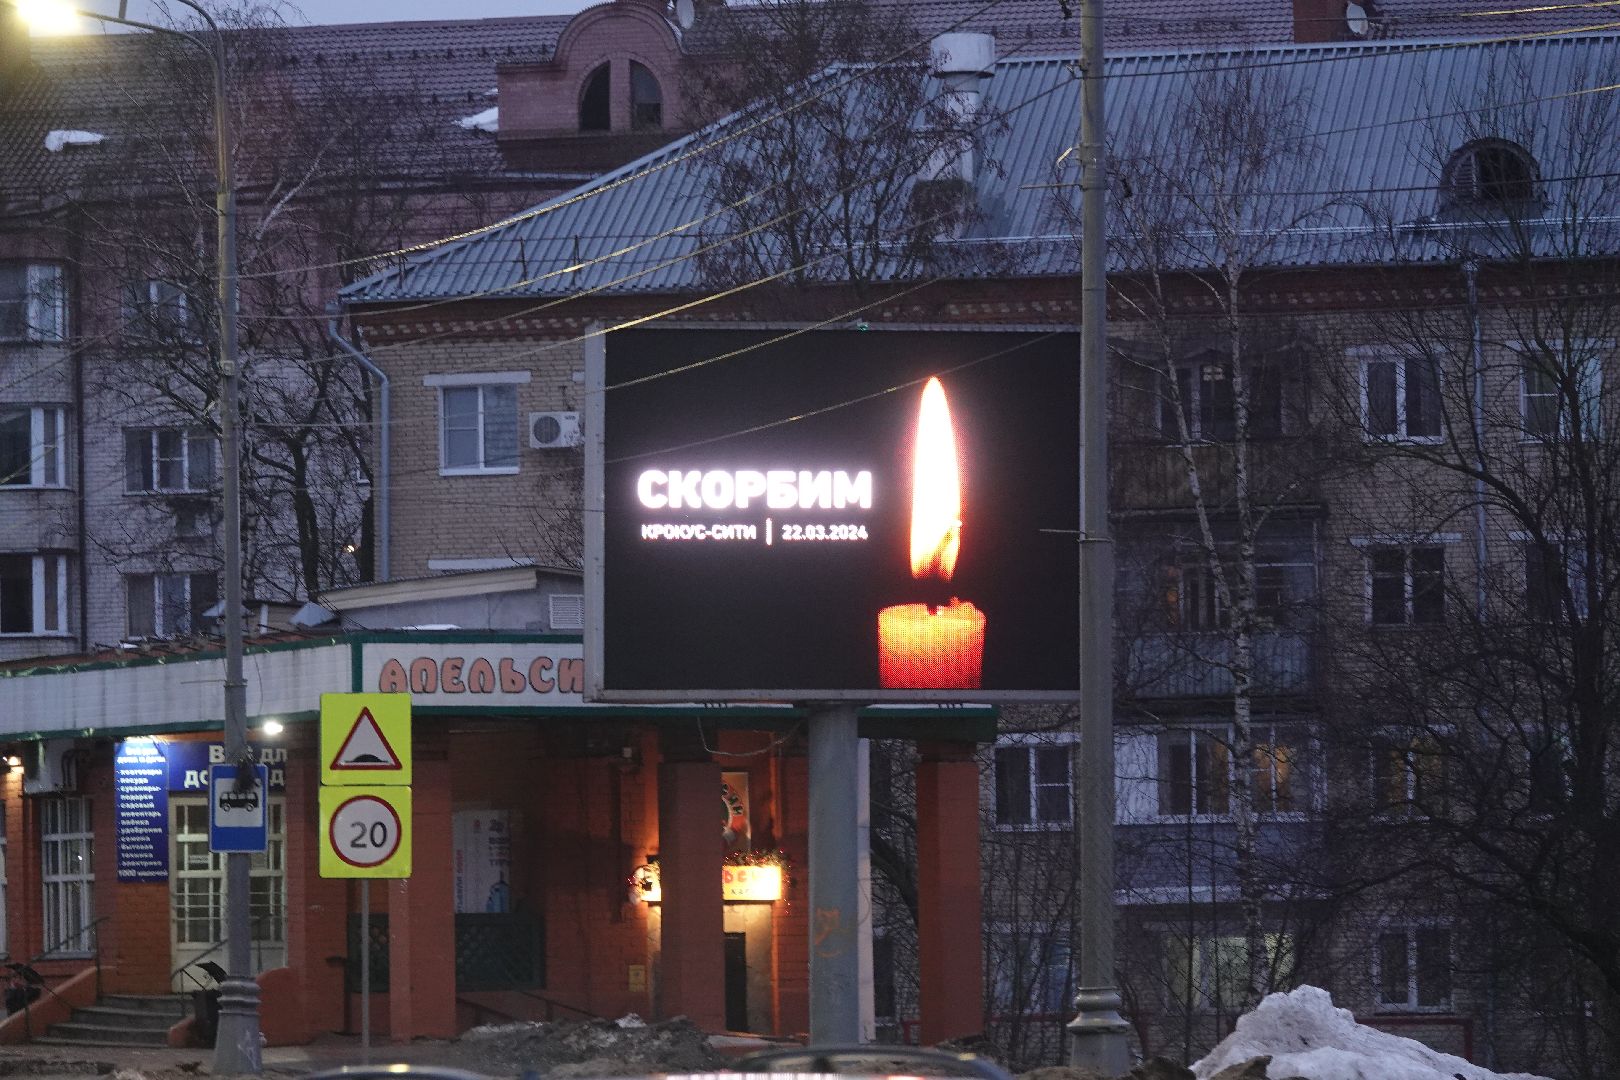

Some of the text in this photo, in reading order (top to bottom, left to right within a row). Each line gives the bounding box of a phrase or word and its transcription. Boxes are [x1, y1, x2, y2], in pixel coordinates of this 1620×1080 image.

[637, 469, 873, 509] СКОРБИМ
[641, 524, 869, 541] КРОКУС-СИТИ 22.03.2024
[379, 656, 584, 693] АПЕЛЬСИ
[350, 821, 387, 848] 20
